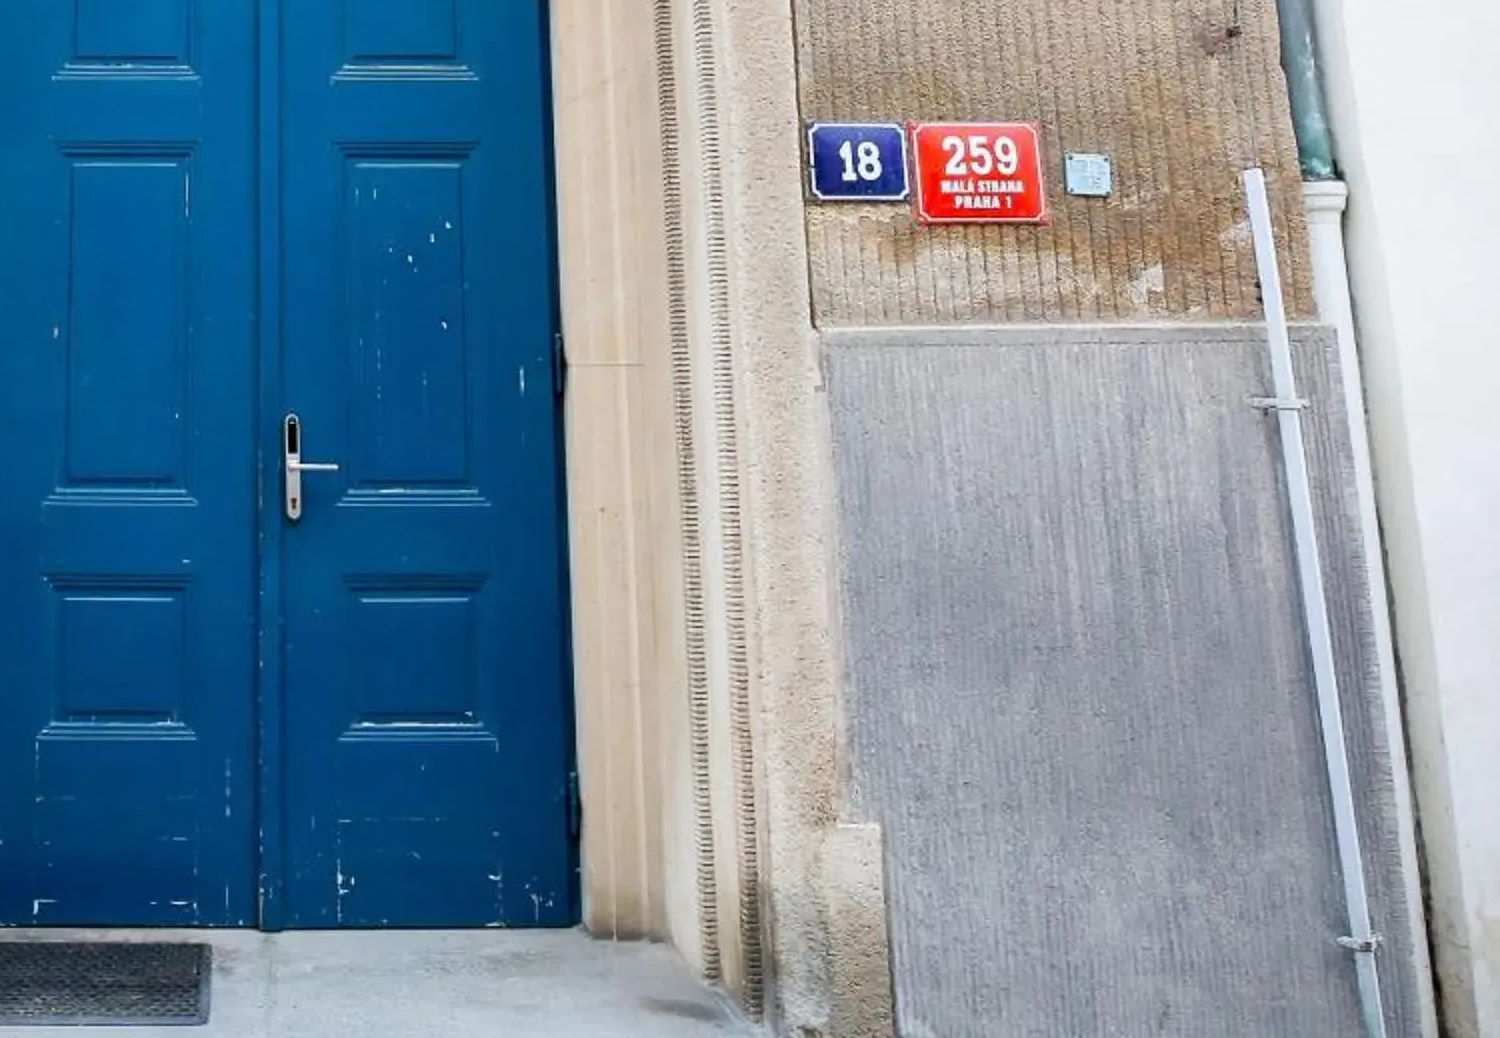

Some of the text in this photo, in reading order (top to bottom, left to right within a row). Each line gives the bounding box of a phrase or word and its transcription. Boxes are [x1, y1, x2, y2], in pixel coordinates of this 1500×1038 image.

[839, 141, 883, 181] 18
[941, 135, 1018, 176] 259
[941, 177, 1025, 194] MALÁ STRANA
[954, 195, 1013, 209] PRAHA 1
